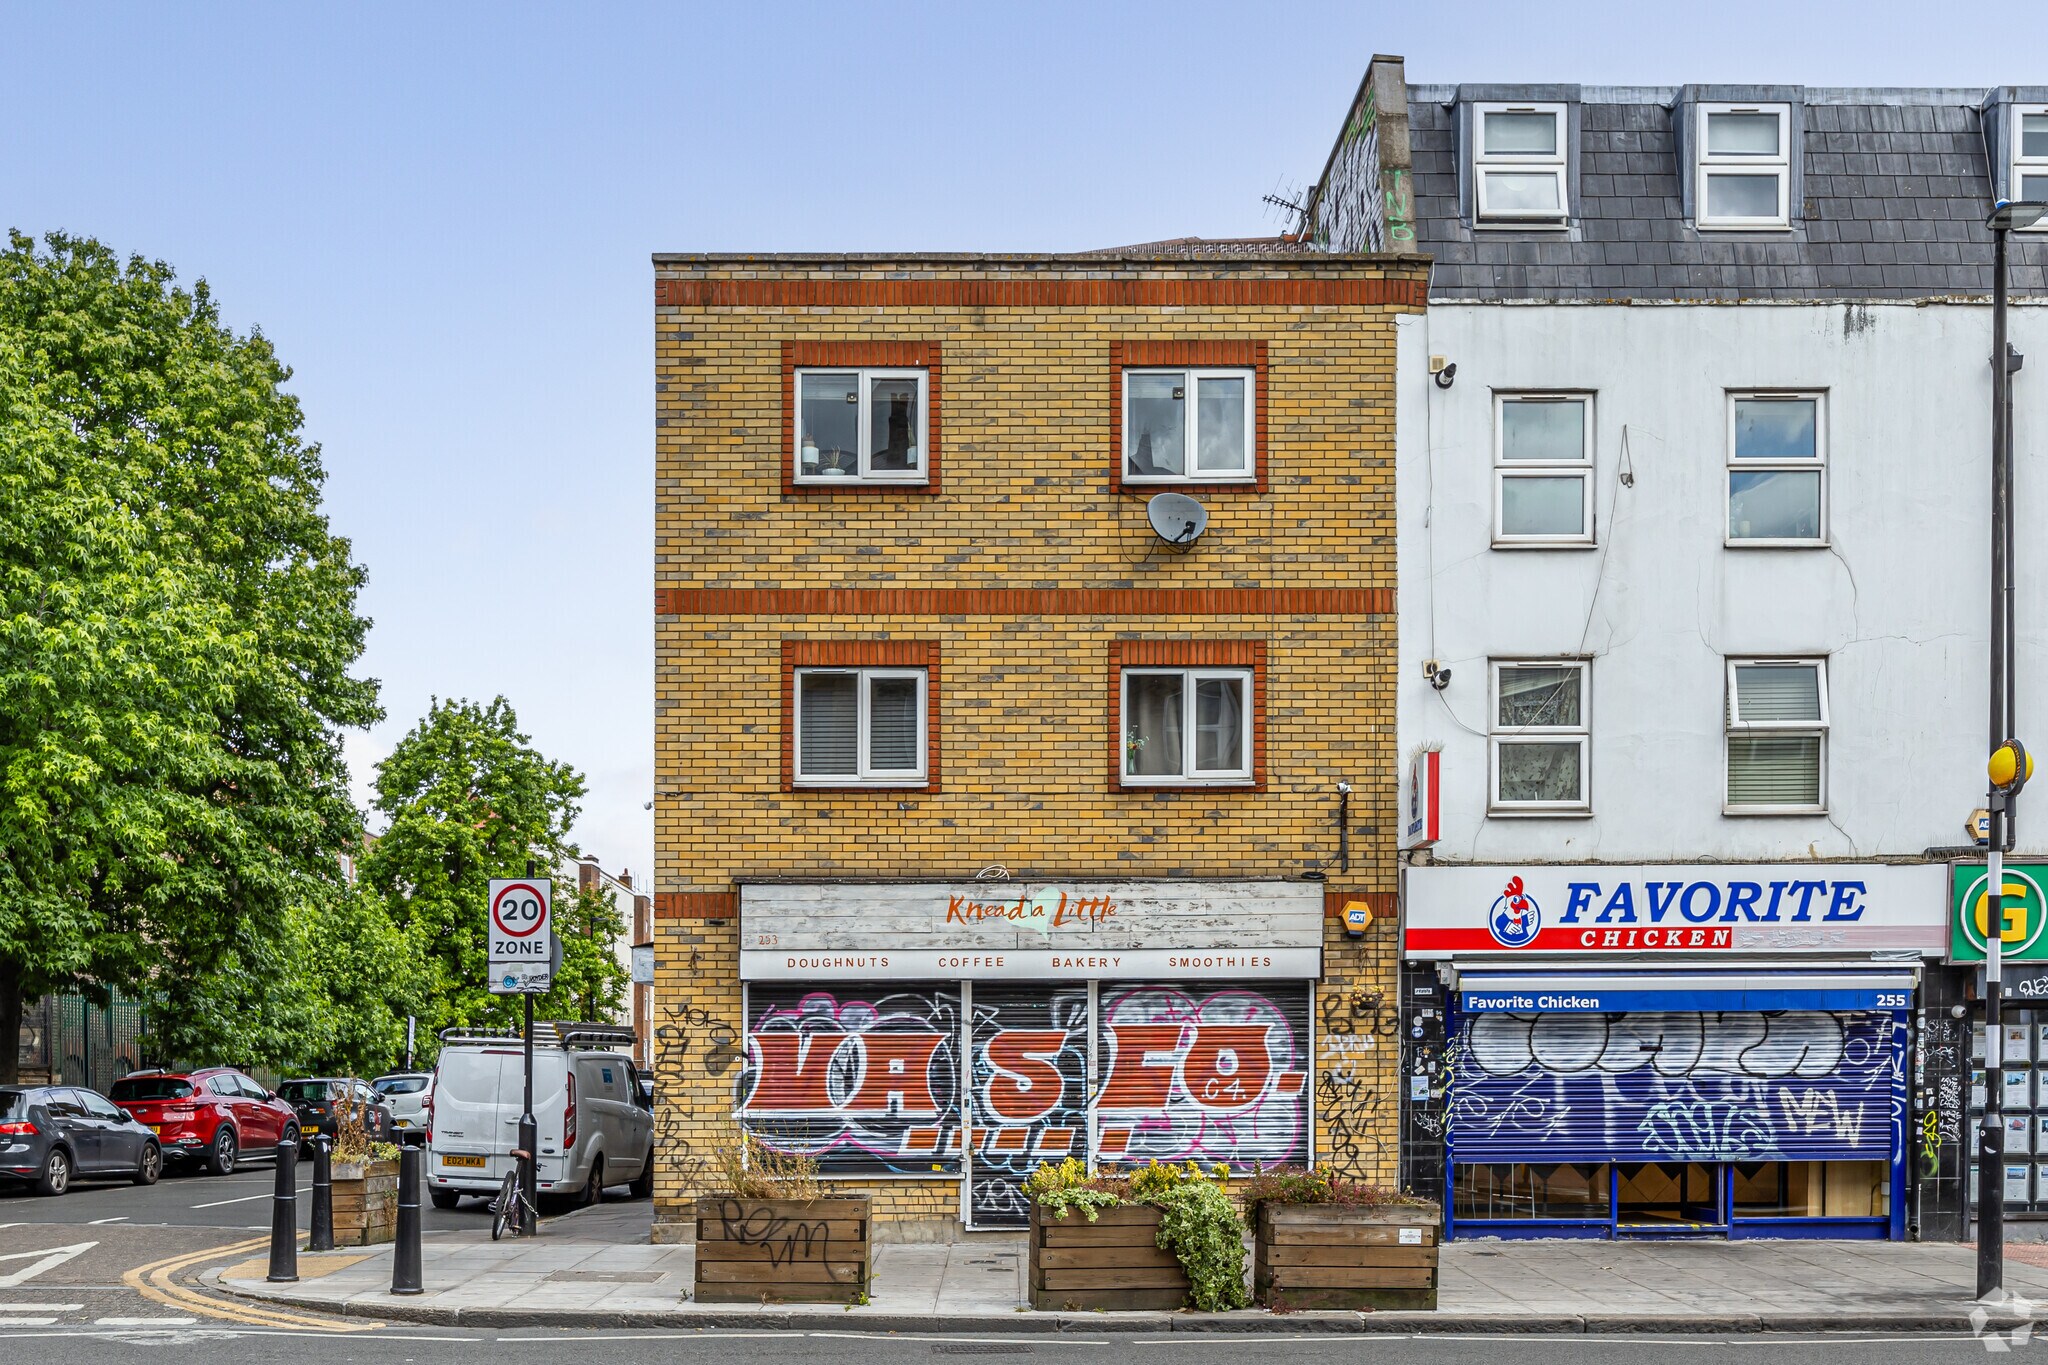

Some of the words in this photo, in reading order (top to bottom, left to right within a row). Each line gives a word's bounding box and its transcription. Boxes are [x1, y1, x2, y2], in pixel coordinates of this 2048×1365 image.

[946, 895, 1027, 925] Knead
[1032, 905, 1044, 916] a
[1053, 891, 1117, 926] Little
[1559, 880, 1867, 923] FAVORITE
[502, 899, 538, 920] 20
[1349, 912, 1365, 922] ADT
[1974, 883, 2028, 943] G
[1580, 929, 1730, 946] CHICKEN
[495, 941, 543, 954] ZONE
[787, 957, 889, 968] DOUGHNUTS
[938, 957, 1004, 968] COFFEE
[1052, 957, 1121, 968] BAKERY
[1169, 957, 1271, 968] SMOOTHIES
[1468, 995, 1534, 1009] Favorite
[1537, 995, 1599, 1009] Chicken
[1876, 994, 1906, 1007] 255
